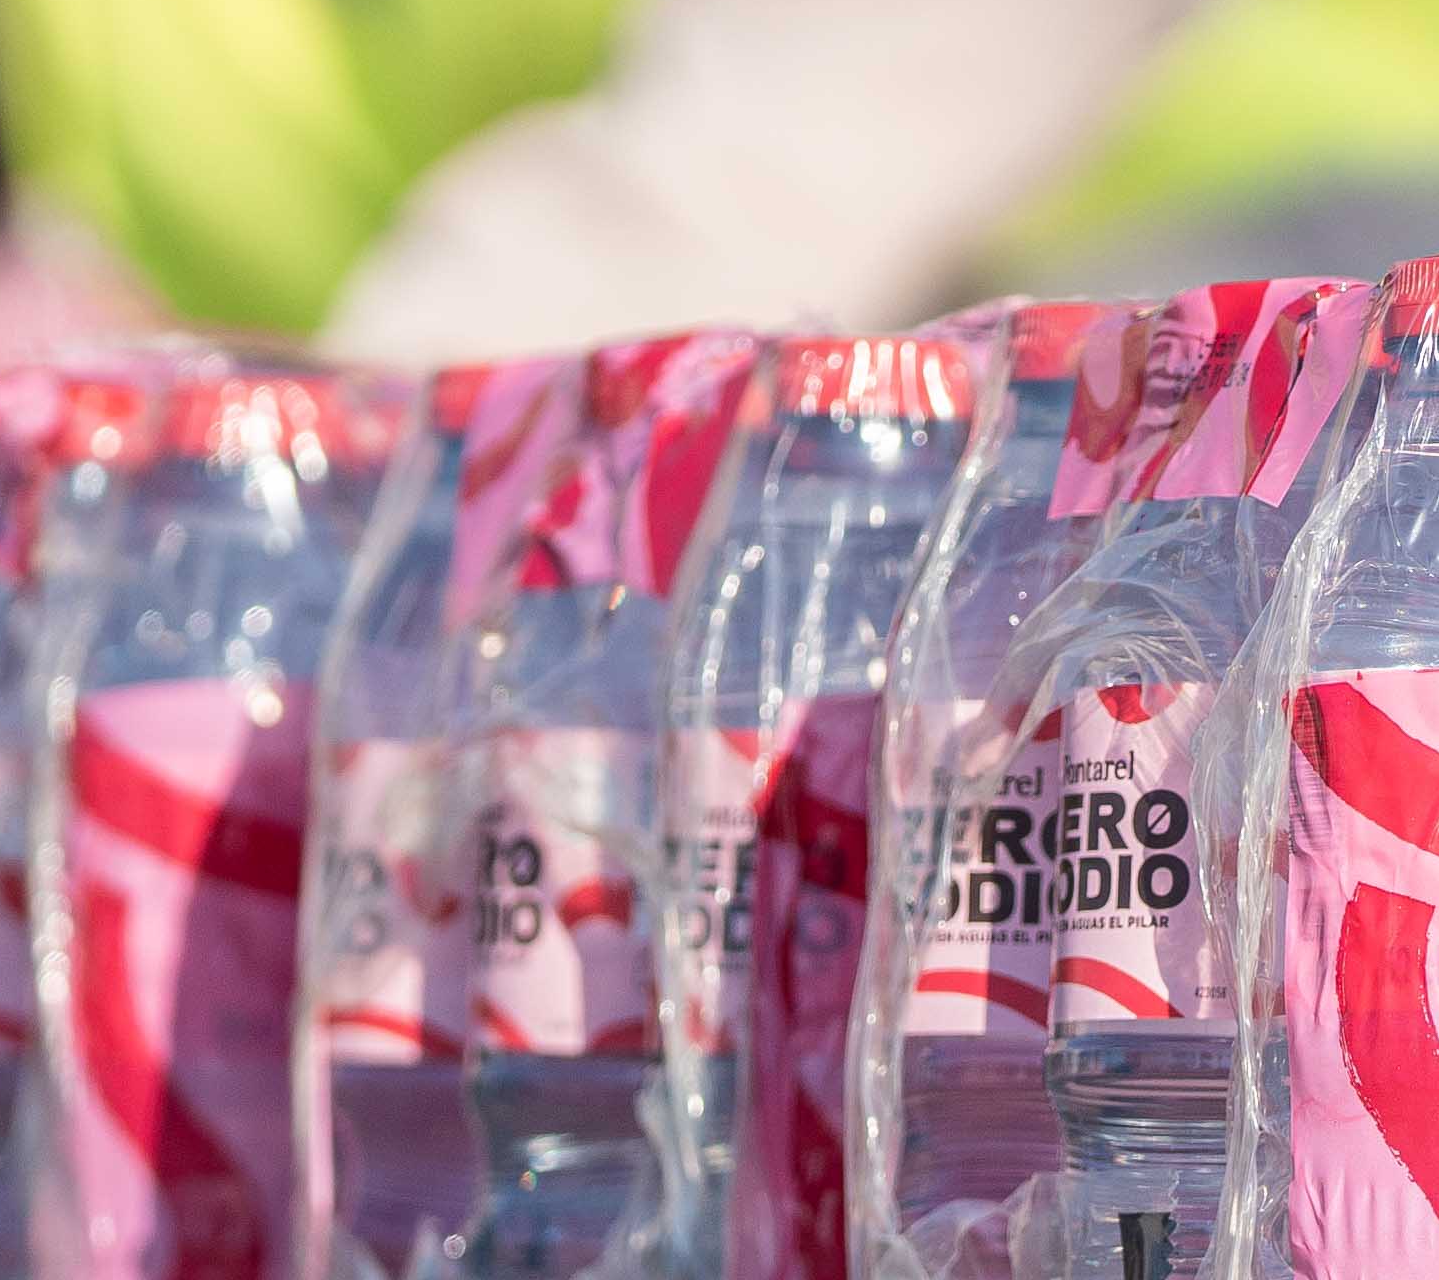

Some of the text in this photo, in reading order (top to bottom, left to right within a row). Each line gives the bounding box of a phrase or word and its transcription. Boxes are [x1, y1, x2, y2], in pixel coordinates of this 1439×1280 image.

[1061, 788, 1190, 853] ERO
[1109, 916, 1124, 929] EL
[1127, 915, 1170, 929] PILAR
